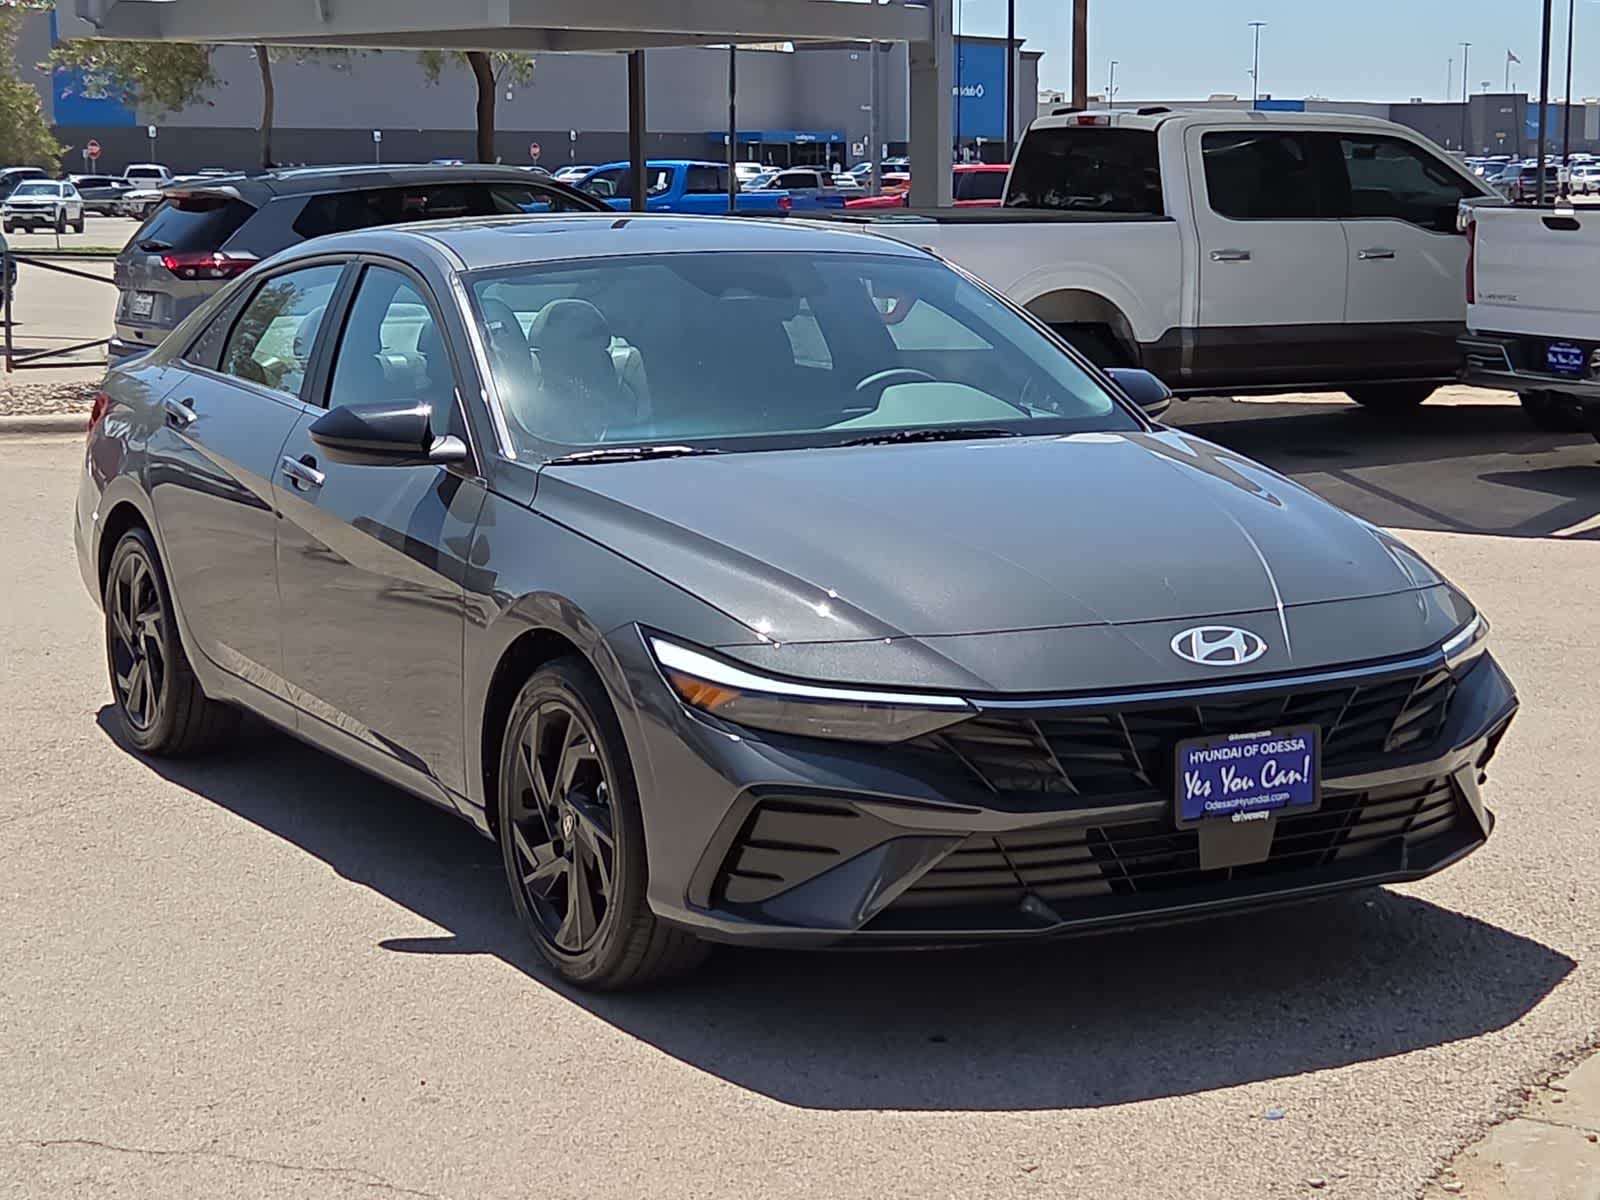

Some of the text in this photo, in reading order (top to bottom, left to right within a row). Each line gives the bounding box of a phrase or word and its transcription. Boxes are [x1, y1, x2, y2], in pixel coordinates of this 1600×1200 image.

[1190, 738, 1306, 765] HYUNDAI OF ODESSA
[1184, 755, 1311, 800] Yes You Can!
[1205, 792, 1290, 811] OdessaHyundai.com
[1231, 810, 1271, 823] driveway
